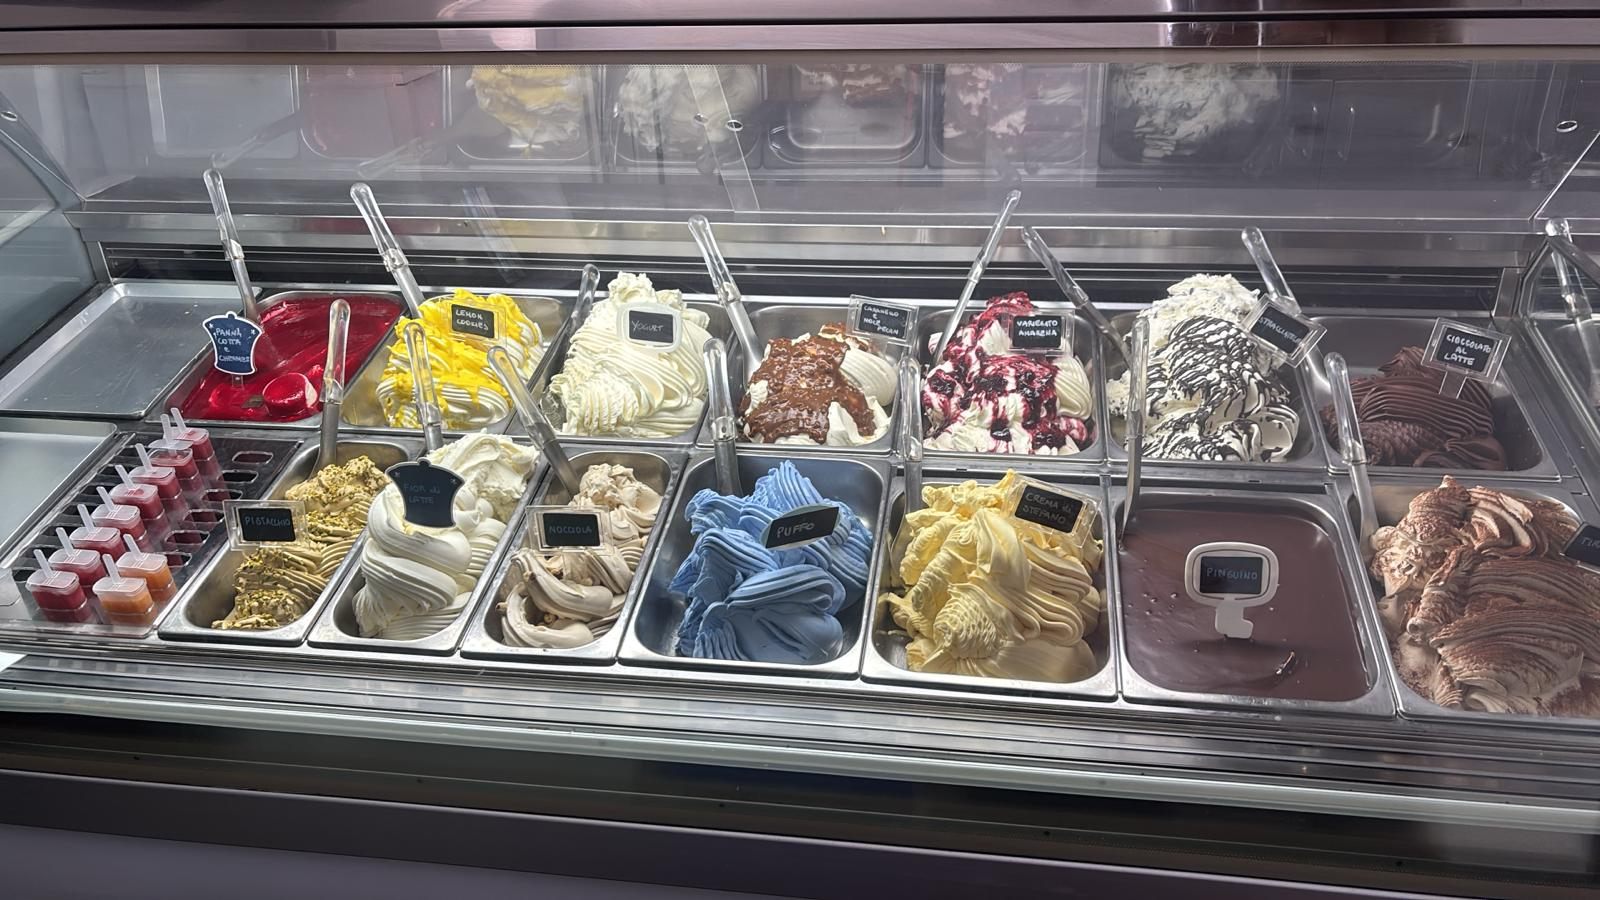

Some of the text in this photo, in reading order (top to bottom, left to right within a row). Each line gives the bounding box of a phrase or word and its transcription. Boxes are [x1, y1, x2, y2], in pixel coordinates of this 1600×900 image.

[455, 309, 483, 320] LEMON
[215, 327, 242, 338] PANNA
[1018, 329, 1058, 337] AMARENA
[217, 337, 242, 346] COTTA
[1446, 334, 1492, 353] CIOCCOLATO
[1455, 346, 1468, 355] AL
[1443, 353, 1475, 366] LATTE
[1025, 492, 1058, 509] CREMA
[549, 525, 593, 534] NOCCIOLA
[776, 521, 815, 539] PUFFO
[1206, 567, 1258, 580] PINGUINO
